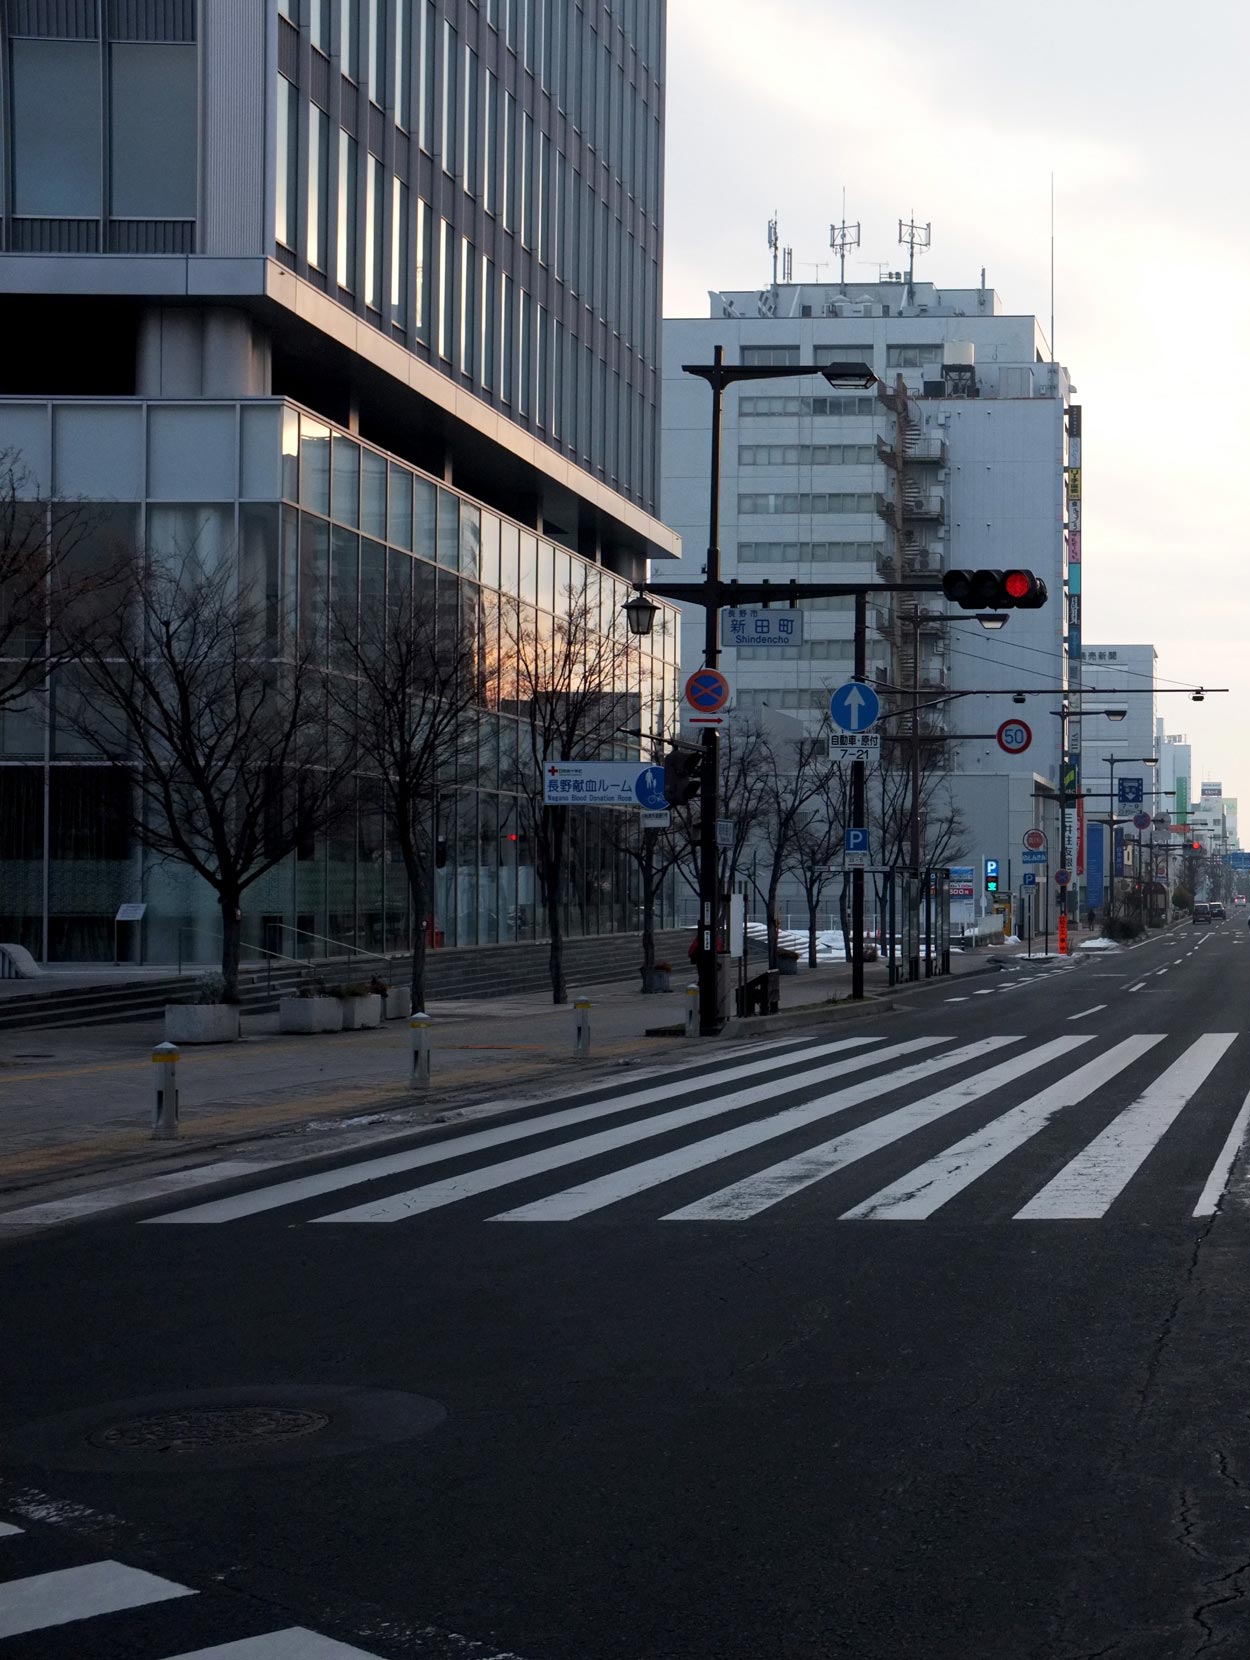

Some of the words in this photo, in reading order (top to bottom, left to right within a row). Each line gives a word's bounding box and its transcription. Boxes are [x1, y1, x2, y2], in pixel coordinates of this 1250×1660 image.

[730, 619, 794, 634] 新田町
[735, 635, 790, 644] Shindencho
[1004, 728, 1024, 744] 50
[548, 779, 632, 793] 長野献血ルーム
[850, 831, 863, 849] P
[987, 861, 997, 873] P
[1026, 875, 1033, 885] P
